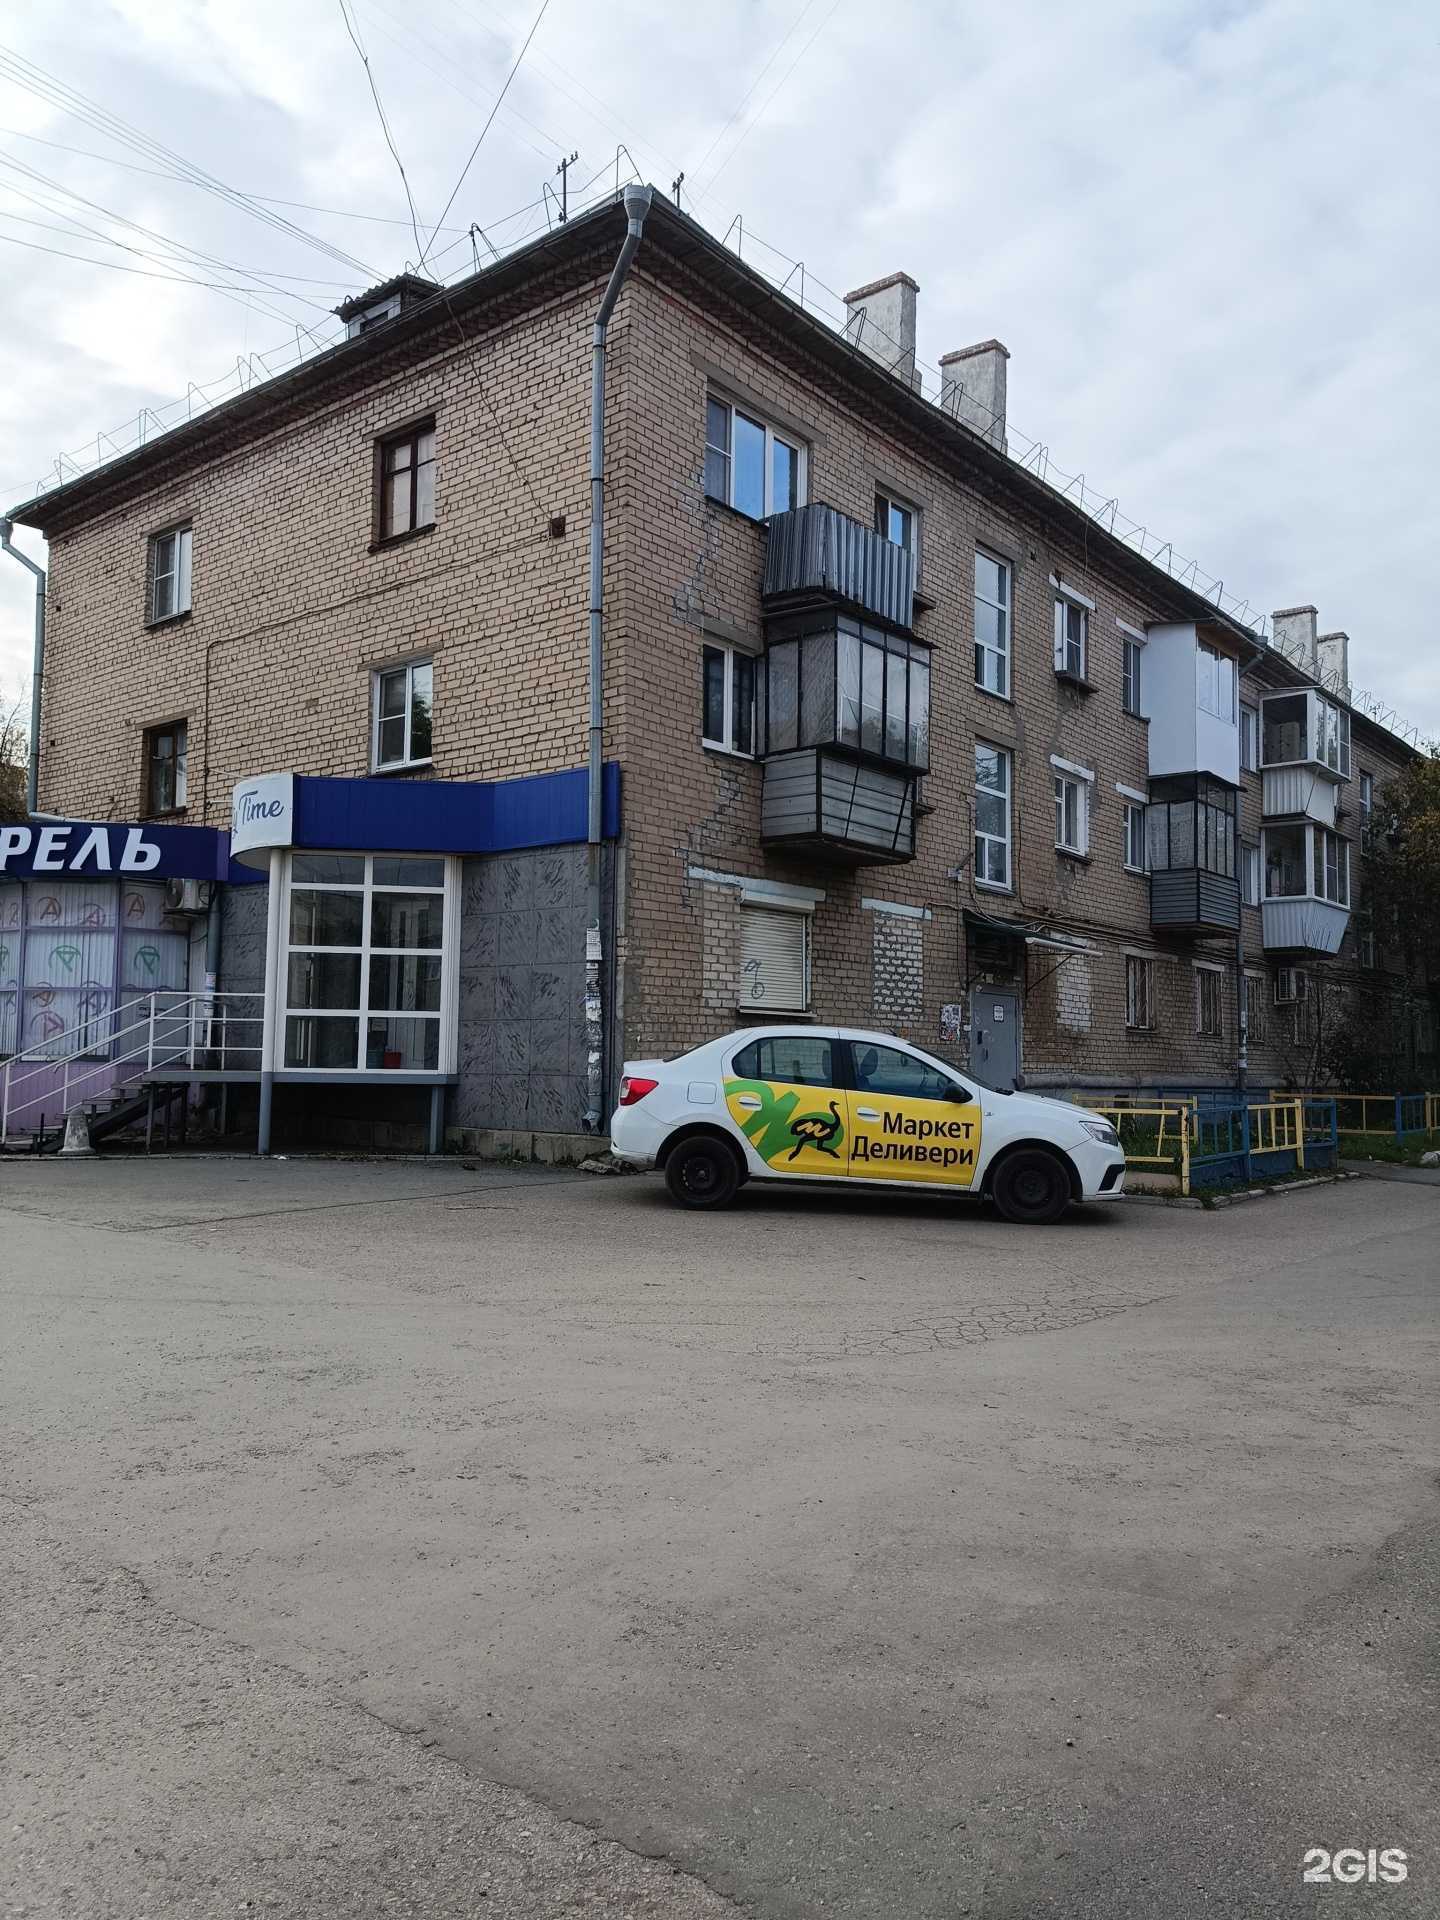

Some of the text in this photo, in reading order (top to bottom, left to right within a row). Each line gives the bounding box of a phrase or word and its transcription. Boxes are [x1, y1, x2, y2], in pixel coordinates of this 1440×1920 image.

[238, 790, 285, 825] Time
[882, 1111, 975, 1140] Маркет
[850, 1135, 974, 1168] Деливери
